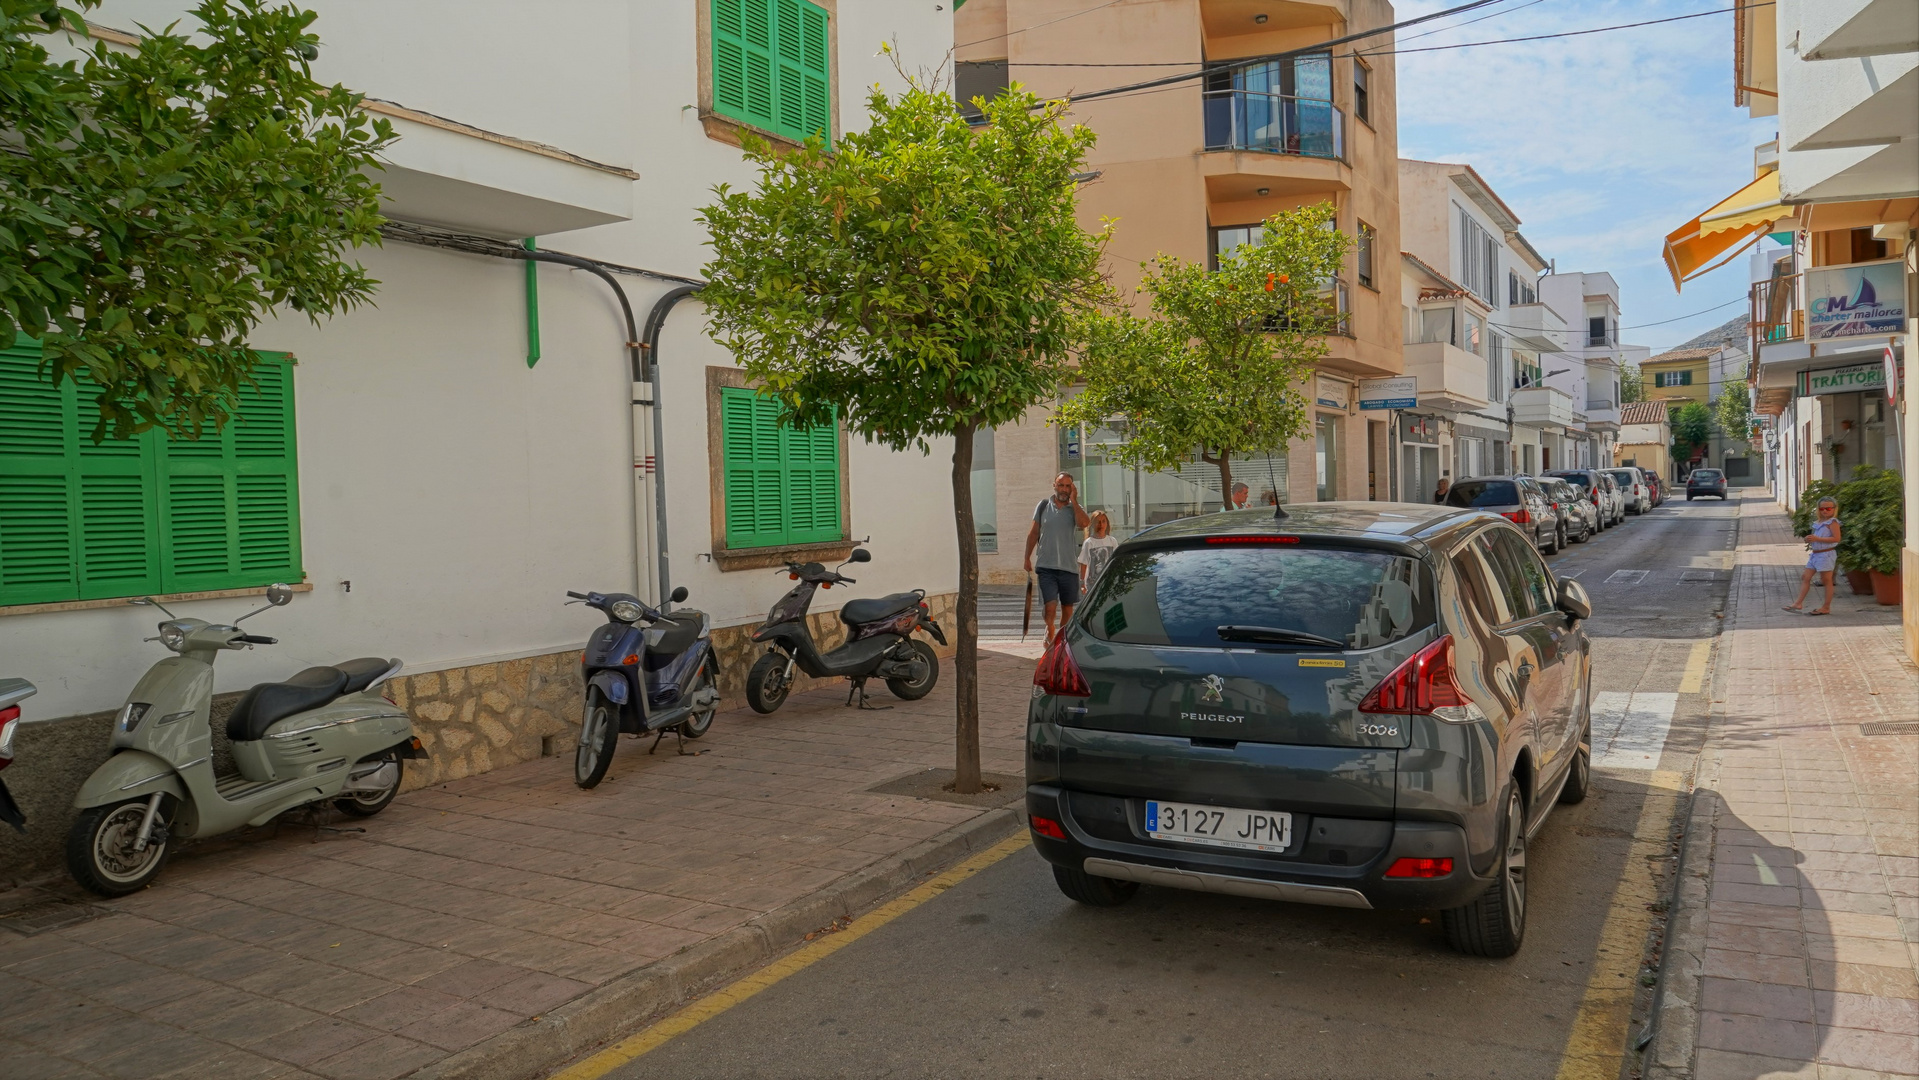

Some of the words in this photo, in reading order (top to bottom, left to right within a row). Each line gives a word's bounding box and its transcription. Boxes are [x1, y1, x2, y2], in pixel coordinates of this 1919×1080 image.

[1811, 296, 1849, 314] CM
[1812, 313, 1852, 323] charter
[1854, 308, 1903, 319] mallorca
[1180, 712, 1245, 723] PEUGEOT
[1357, 723, 1398, 736] 3008
[1163, 807, 1225, 835] 3127
[1237, 814, 1285, 842] JPN
